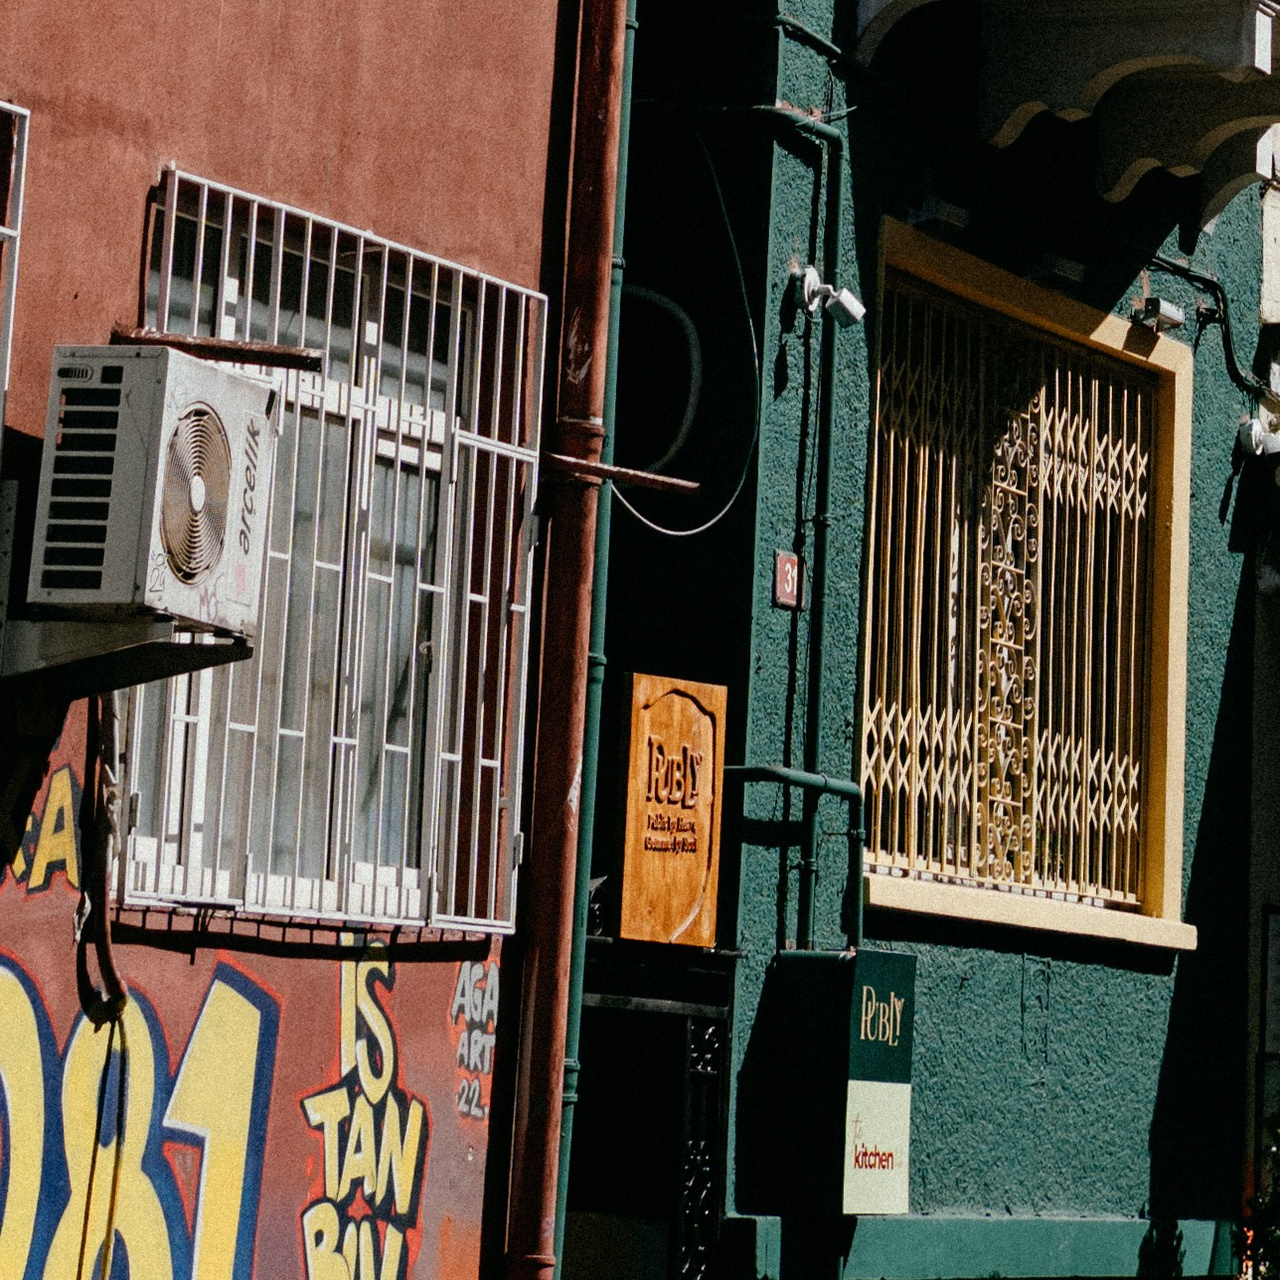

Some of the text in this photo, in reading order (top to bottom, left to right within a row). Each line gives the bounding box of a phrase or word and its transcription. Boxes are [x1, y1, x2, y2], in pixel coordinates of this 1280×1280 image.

[239, 418, 261, 555] arçelik
[784, 562, 798, 596] 31
[646, 734, 703, 809] PUBLY
[452, 960, 499, 1027] AGA
[860, 985, 905, 1047] PUBLY
[456, 1029, 496, 1075] ART
[303, 1087, 424, 1215] TAN
[854, 1142, 894, 1170] kitchen
